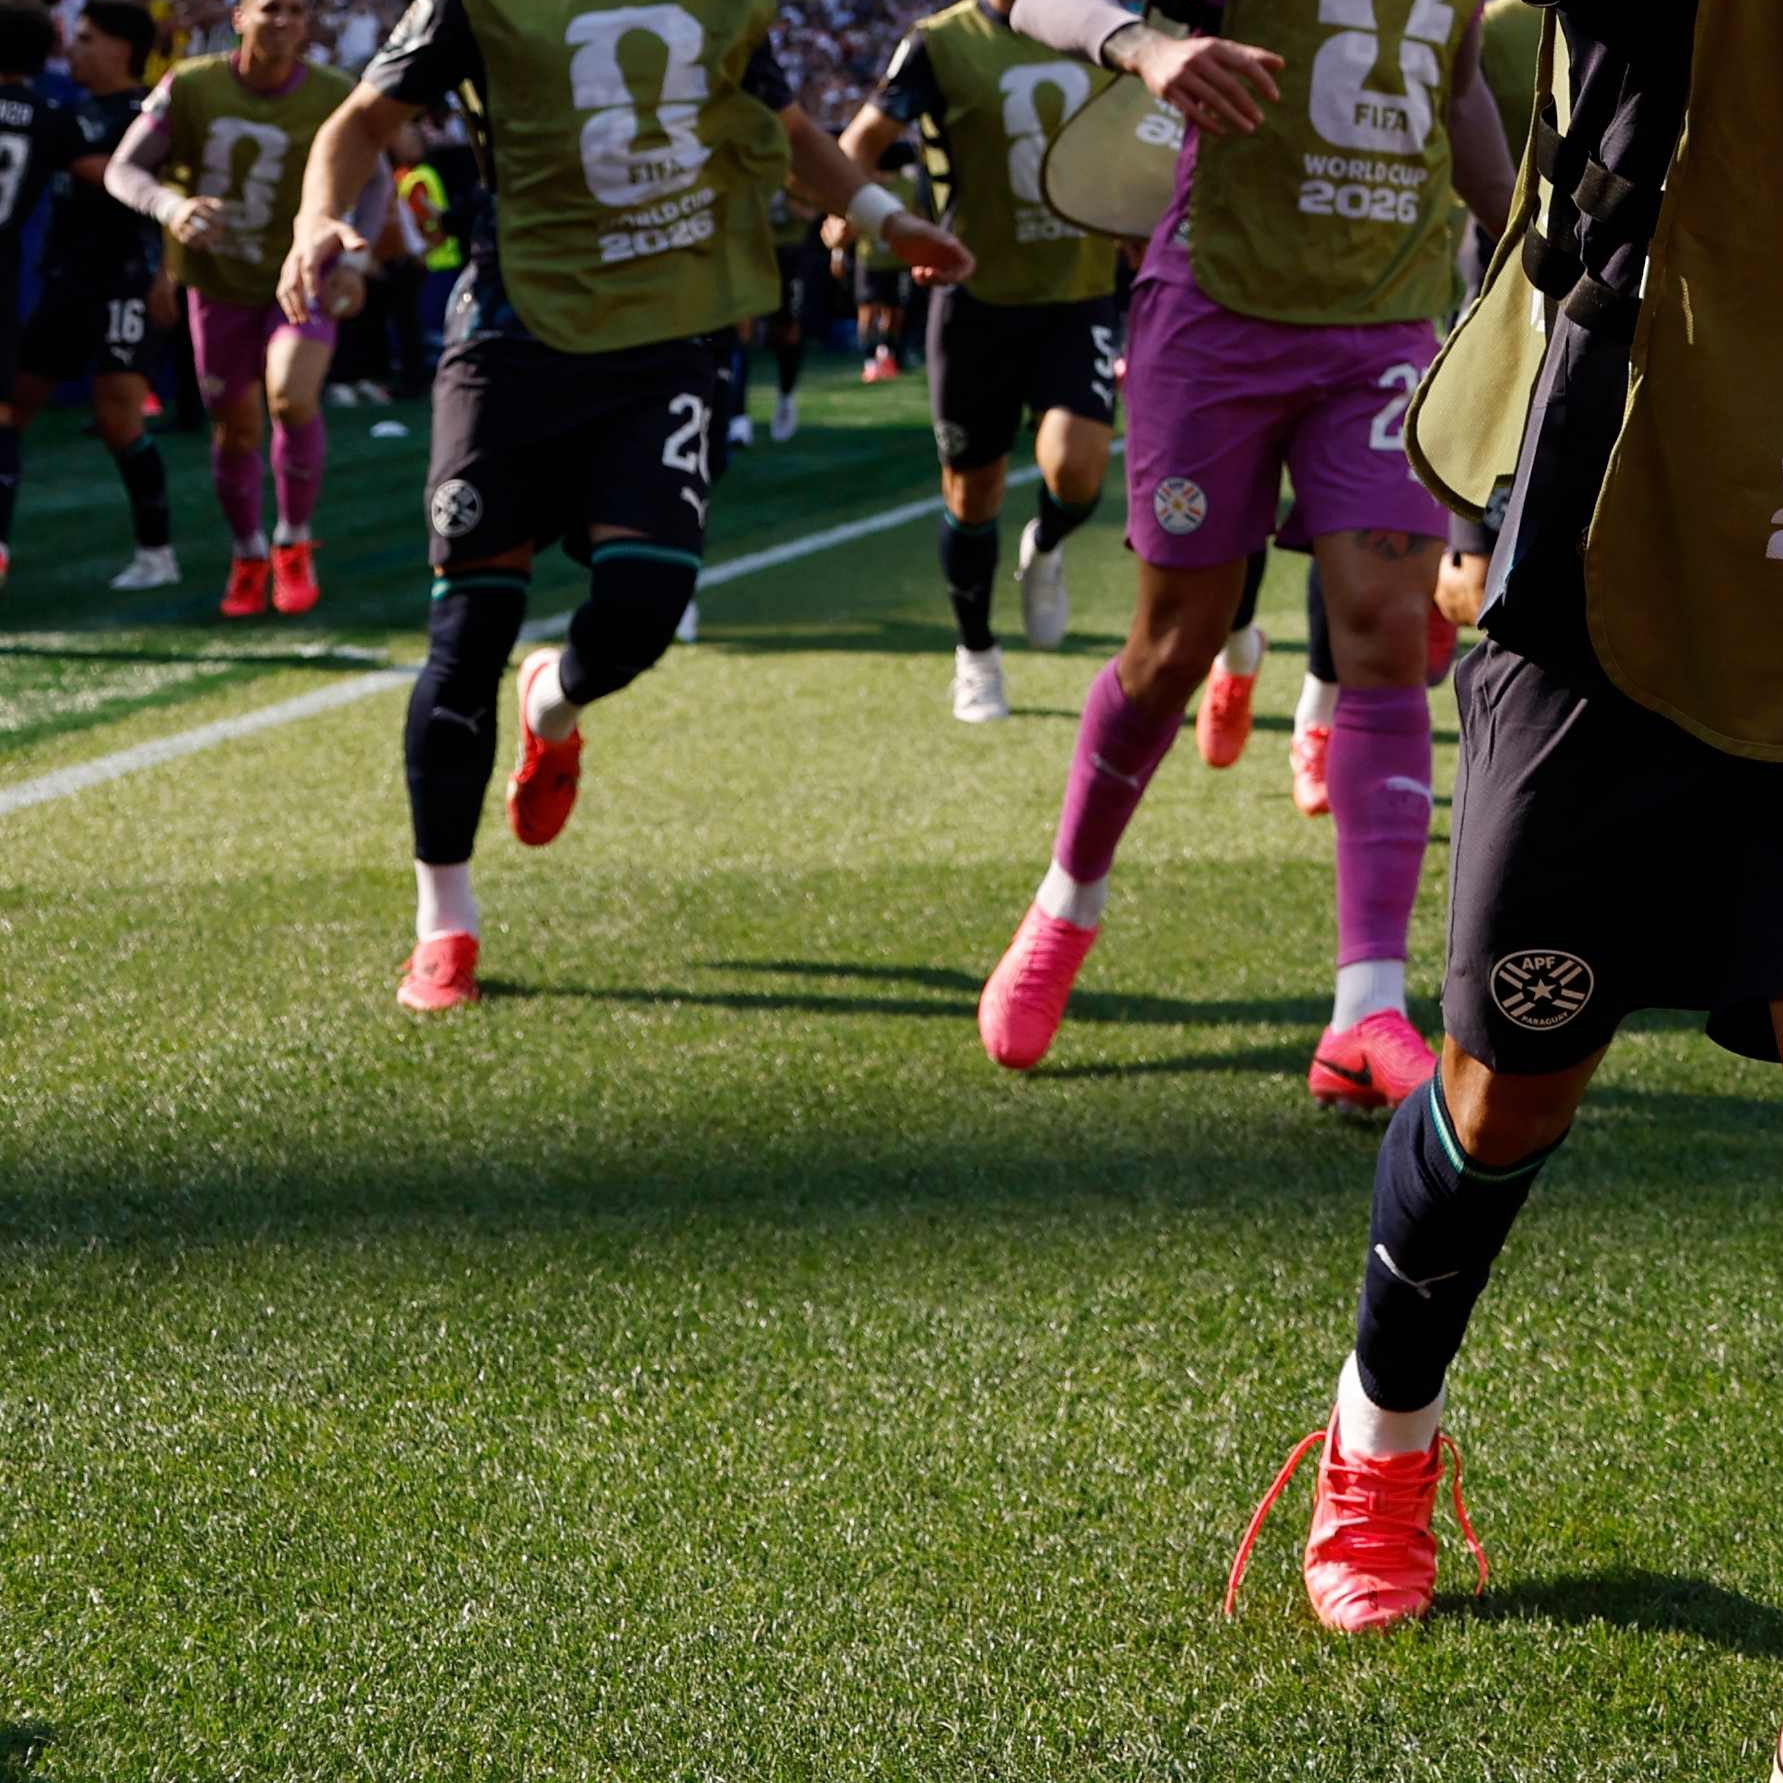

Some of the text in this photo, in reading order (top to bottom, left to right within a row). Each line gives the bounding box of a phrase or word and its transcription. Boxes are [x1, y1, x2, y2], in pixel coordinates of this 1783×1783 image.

[1354, 104, 1409, 133] FIFA
[1304, 153, 1429, 187] WORLD CUP
[1298, 178, 1419, 224] 2026
[598, 210, 715, 262] 2026
[106, 299, 145, 344] 16
[1522, 956, 1556, 971] APF
[1521, 1011, 1568, 1026] PARAGUAY
